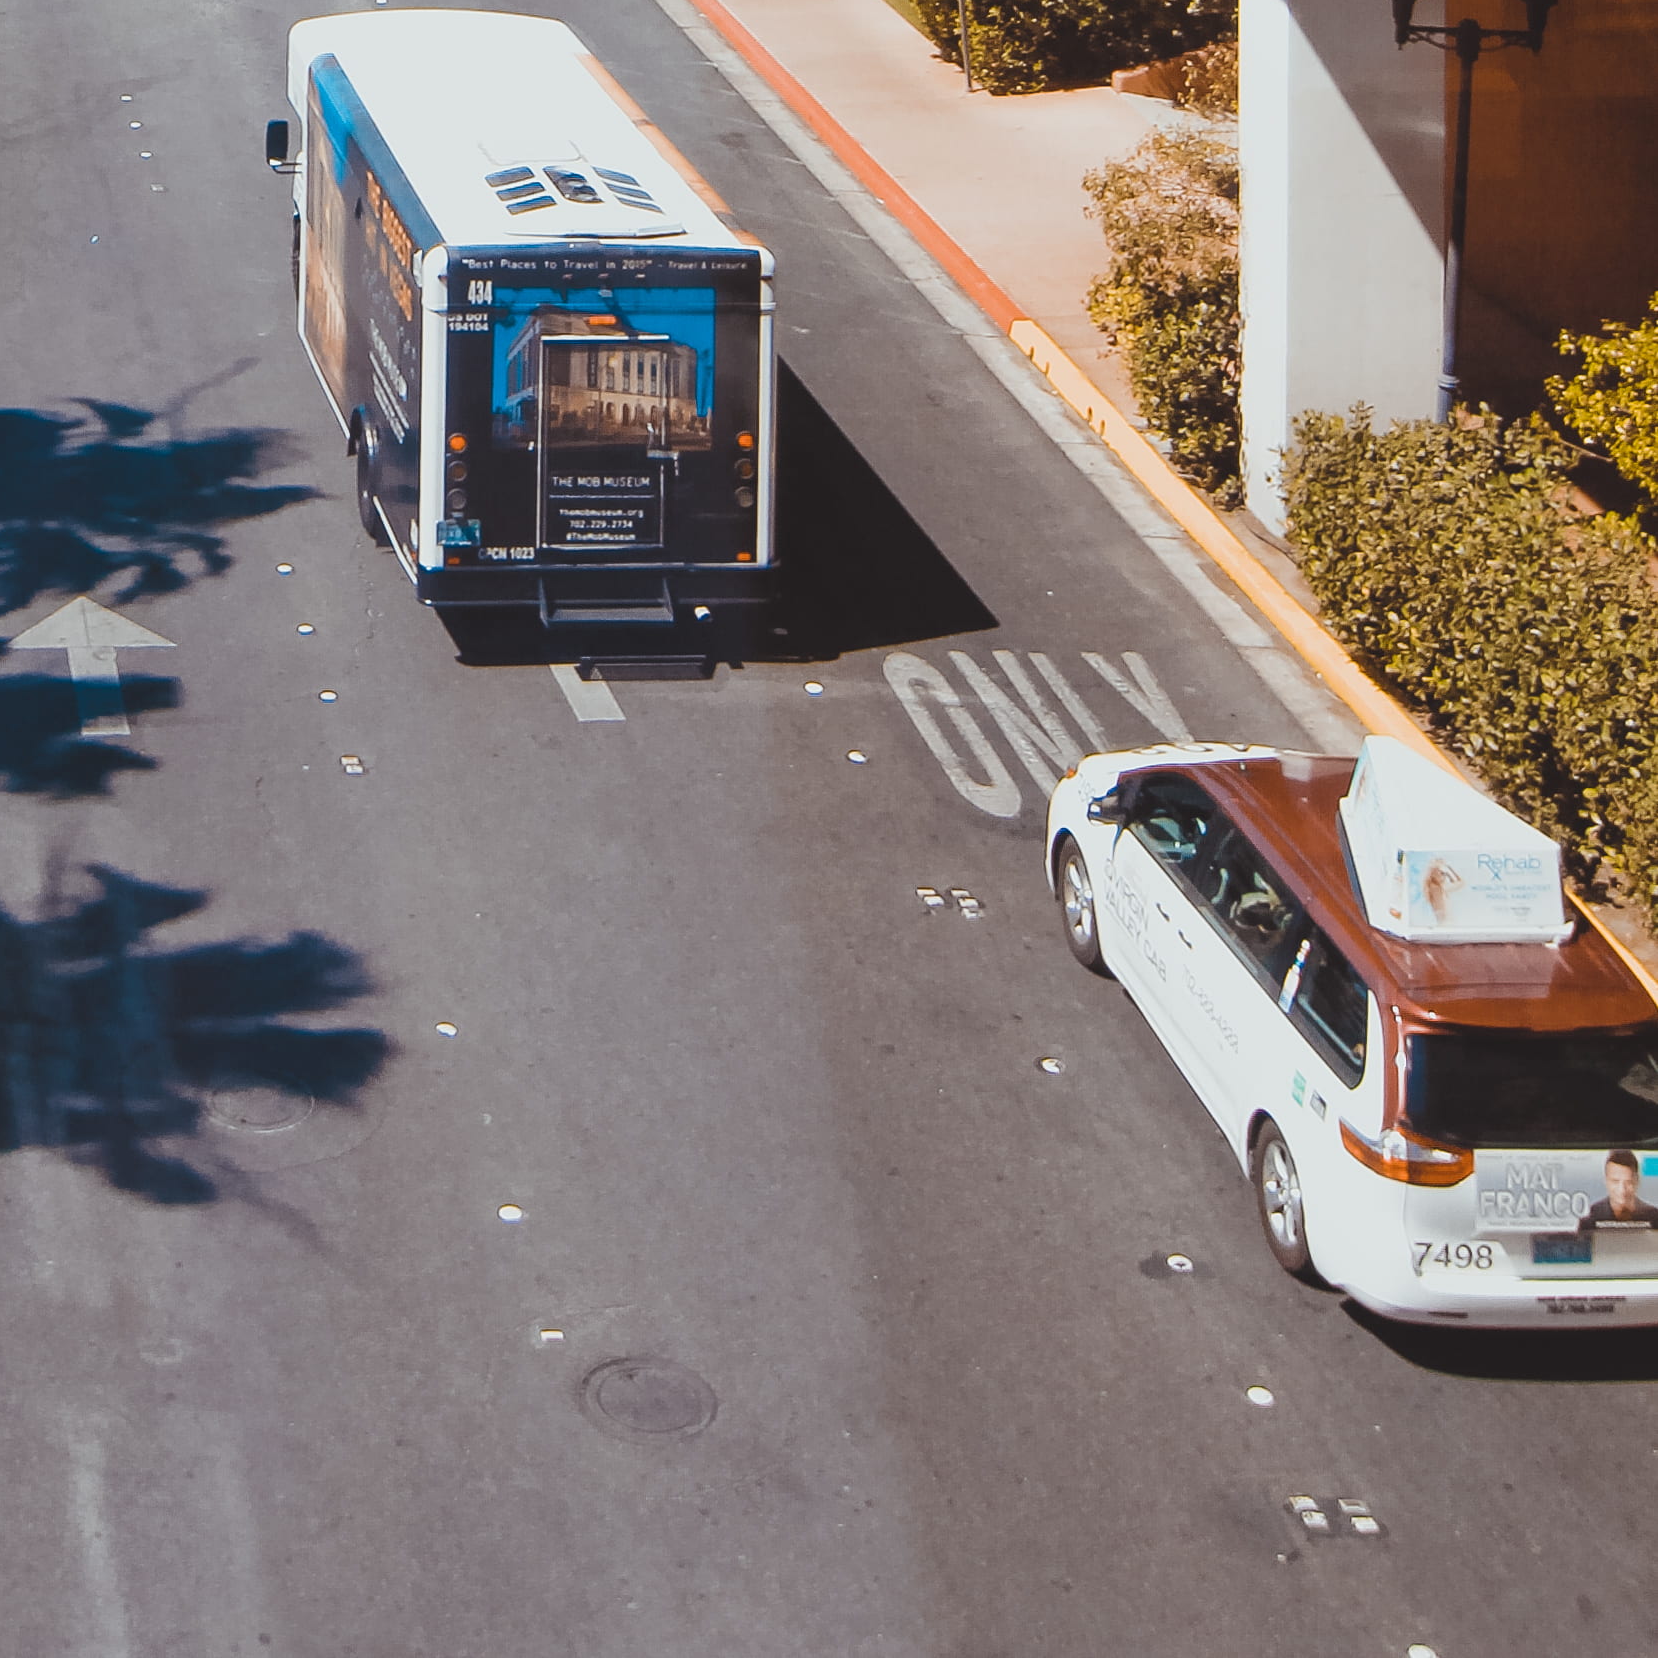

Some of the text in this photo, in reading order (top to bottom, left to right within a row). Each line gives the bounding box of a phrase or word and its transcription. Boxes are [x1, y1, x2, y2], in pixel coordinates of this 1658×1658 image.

[500, 258, 537, 270] Places
[544, 259, 557, 270] to
[563, 260, 599, 270] Travel
[605, 260, 616, 270] in
[467, 280, 493, 305] 434
[551, 476, 651, 488] THE MOB MUSEUM
[509, 547, 535, 560] 1023
[1505, 1162, 1564, 1190] MAT
[1480, 1190, 1589, 1218] FRANCO
[1414, 1242, 1494, 1269] 7498
